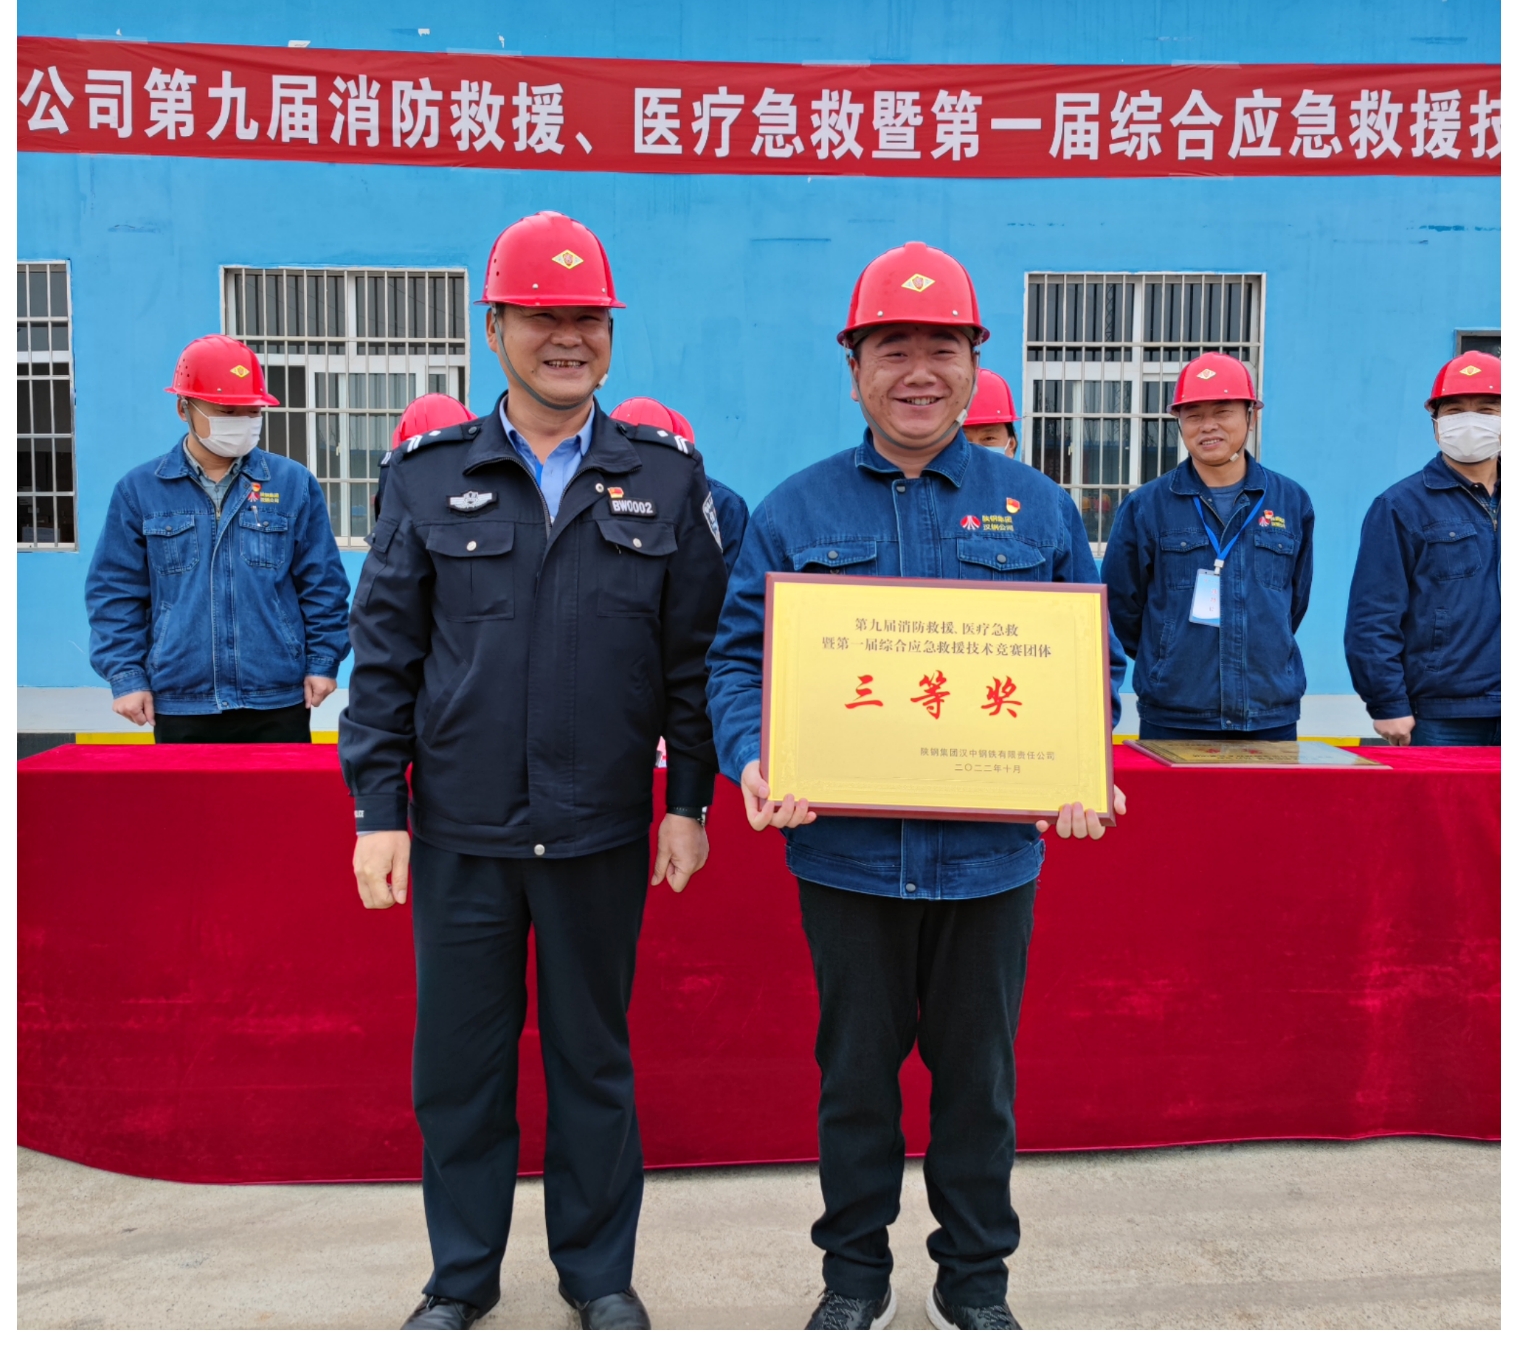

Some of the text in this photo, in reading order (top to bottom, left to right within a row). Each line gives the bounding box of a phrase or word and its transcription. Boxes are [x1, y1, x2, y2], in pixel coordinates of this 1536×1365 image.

[611, 500, 654, 515] BW0002
[854, 617, 1019, 638] 第九届消防救援、医疗急救
[821, 636, 1052, 658] 暨第一届综合应急救援技术竞赛团体
[844, 669, 1023, 719] 三等奖
[920, 746, 1056, 762] 陕钢集团汉中钢铁有限责任公司
